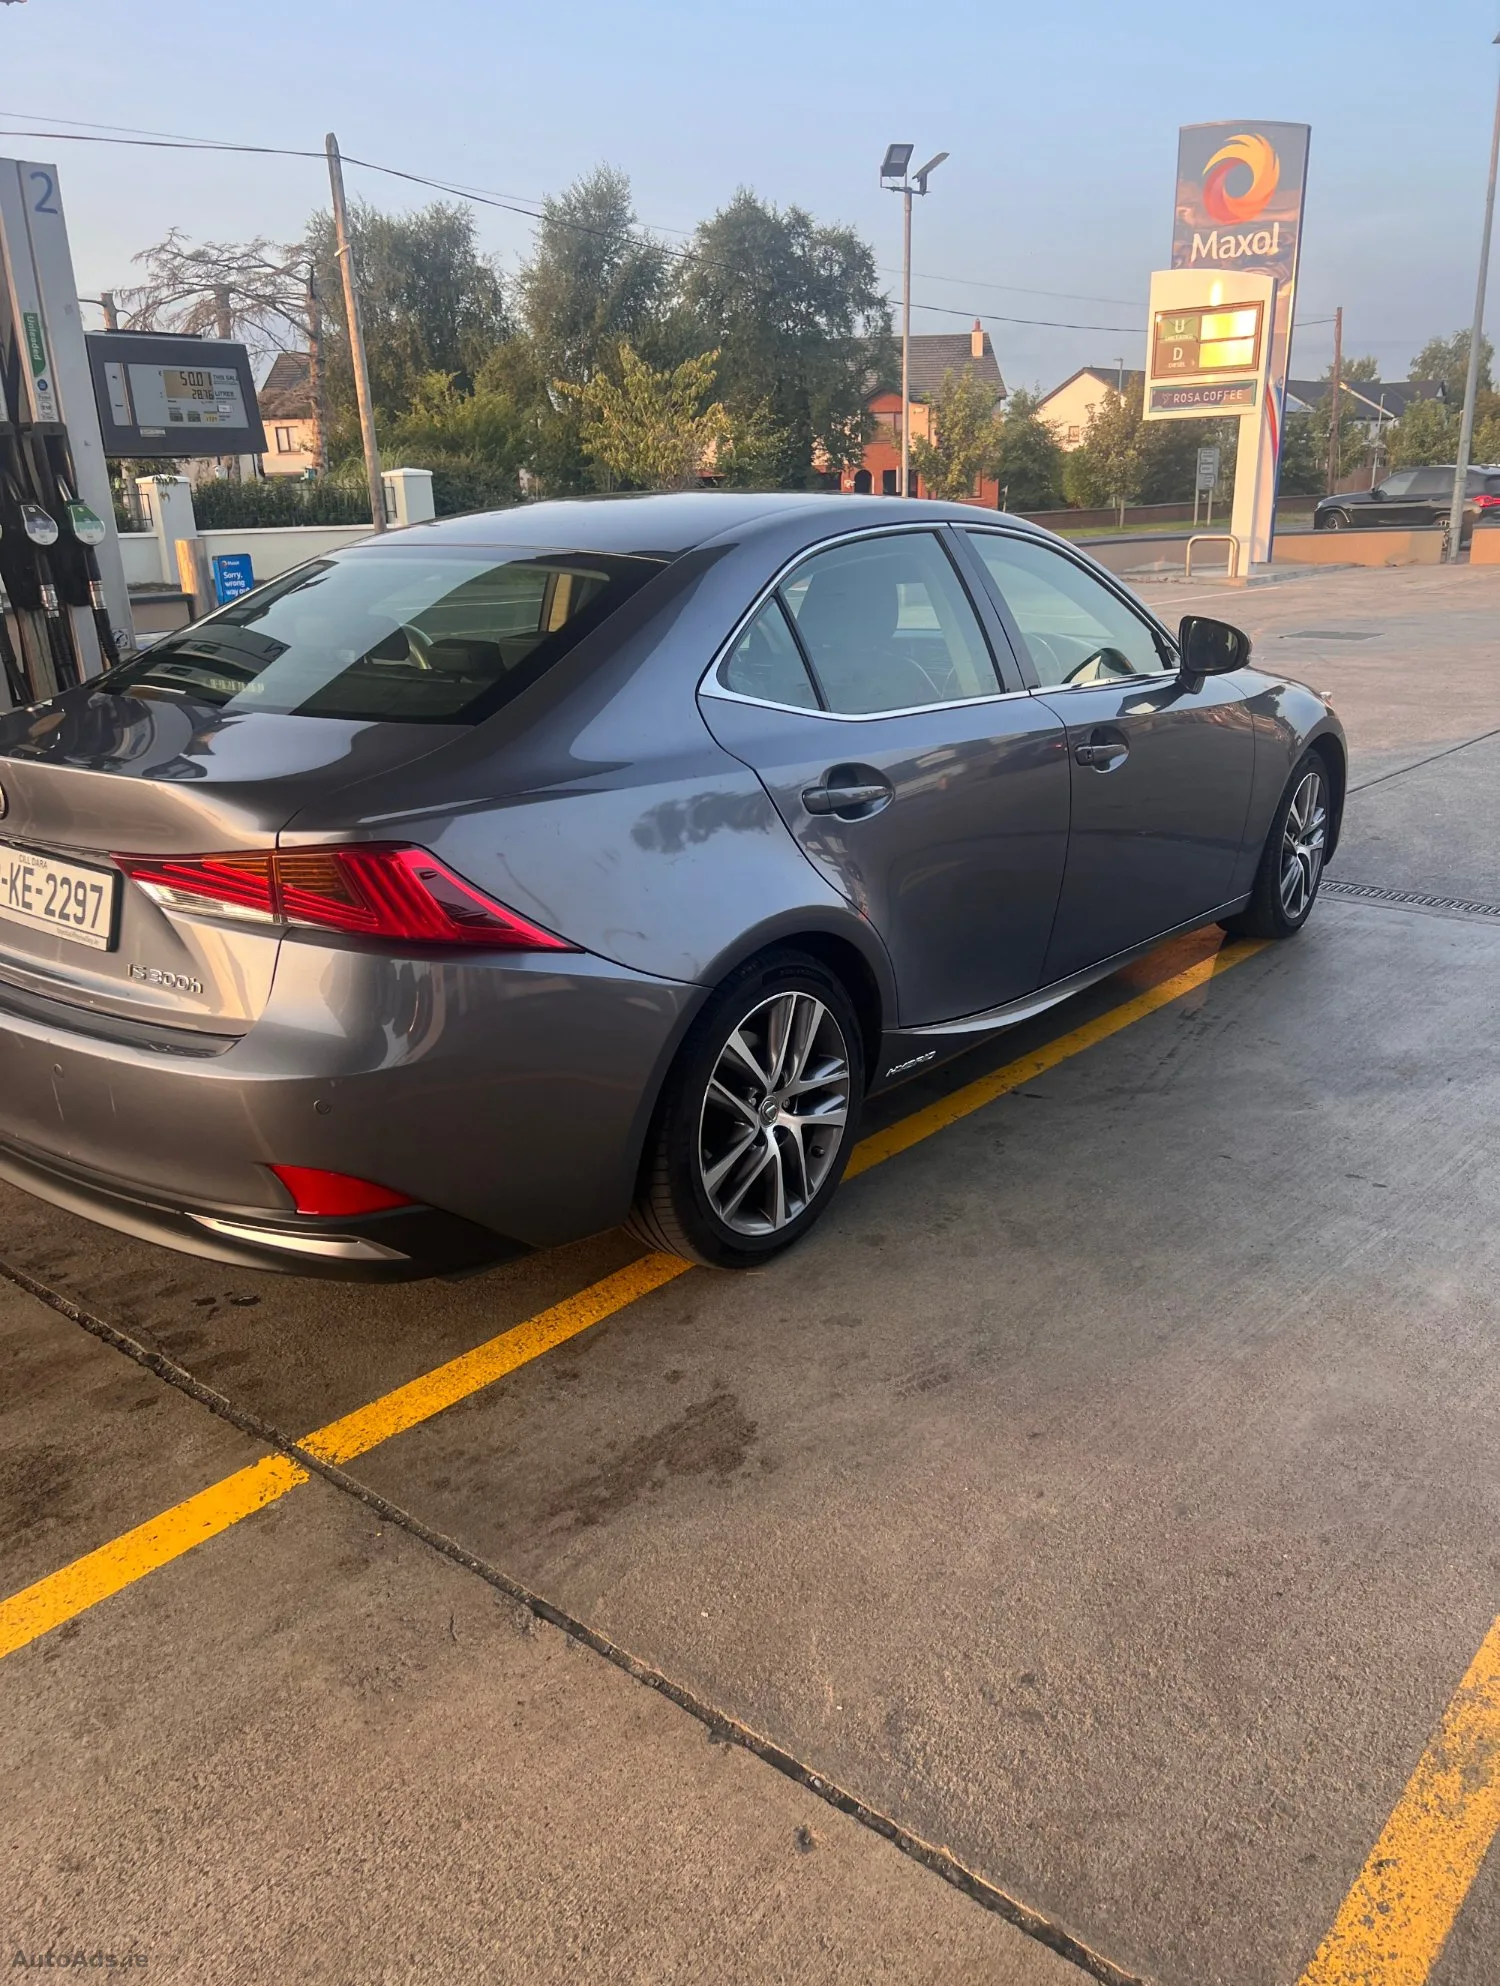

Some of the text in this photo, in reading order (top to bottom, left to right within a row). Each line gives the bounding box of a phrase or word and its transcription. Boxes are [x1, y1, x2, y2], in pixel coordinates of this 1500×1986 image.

[30, 171, 58, 214] 2
[1190, 222, 1280, 263] Maxol
[1174, 319, 1185, 333] U
[27, 315, 42, 361] Unleaded
[1173, 347, 1183, 361] D
[1173, 389, 1243, 404] ROSA COFFEE
[223, 571, 243, 579] Sorry,
[224, 580, 246, 588] wrong
[226, 588, 239, 597] way
[31, 857, 48, 869] DARA
[149, 968, 203, 994] 300h
